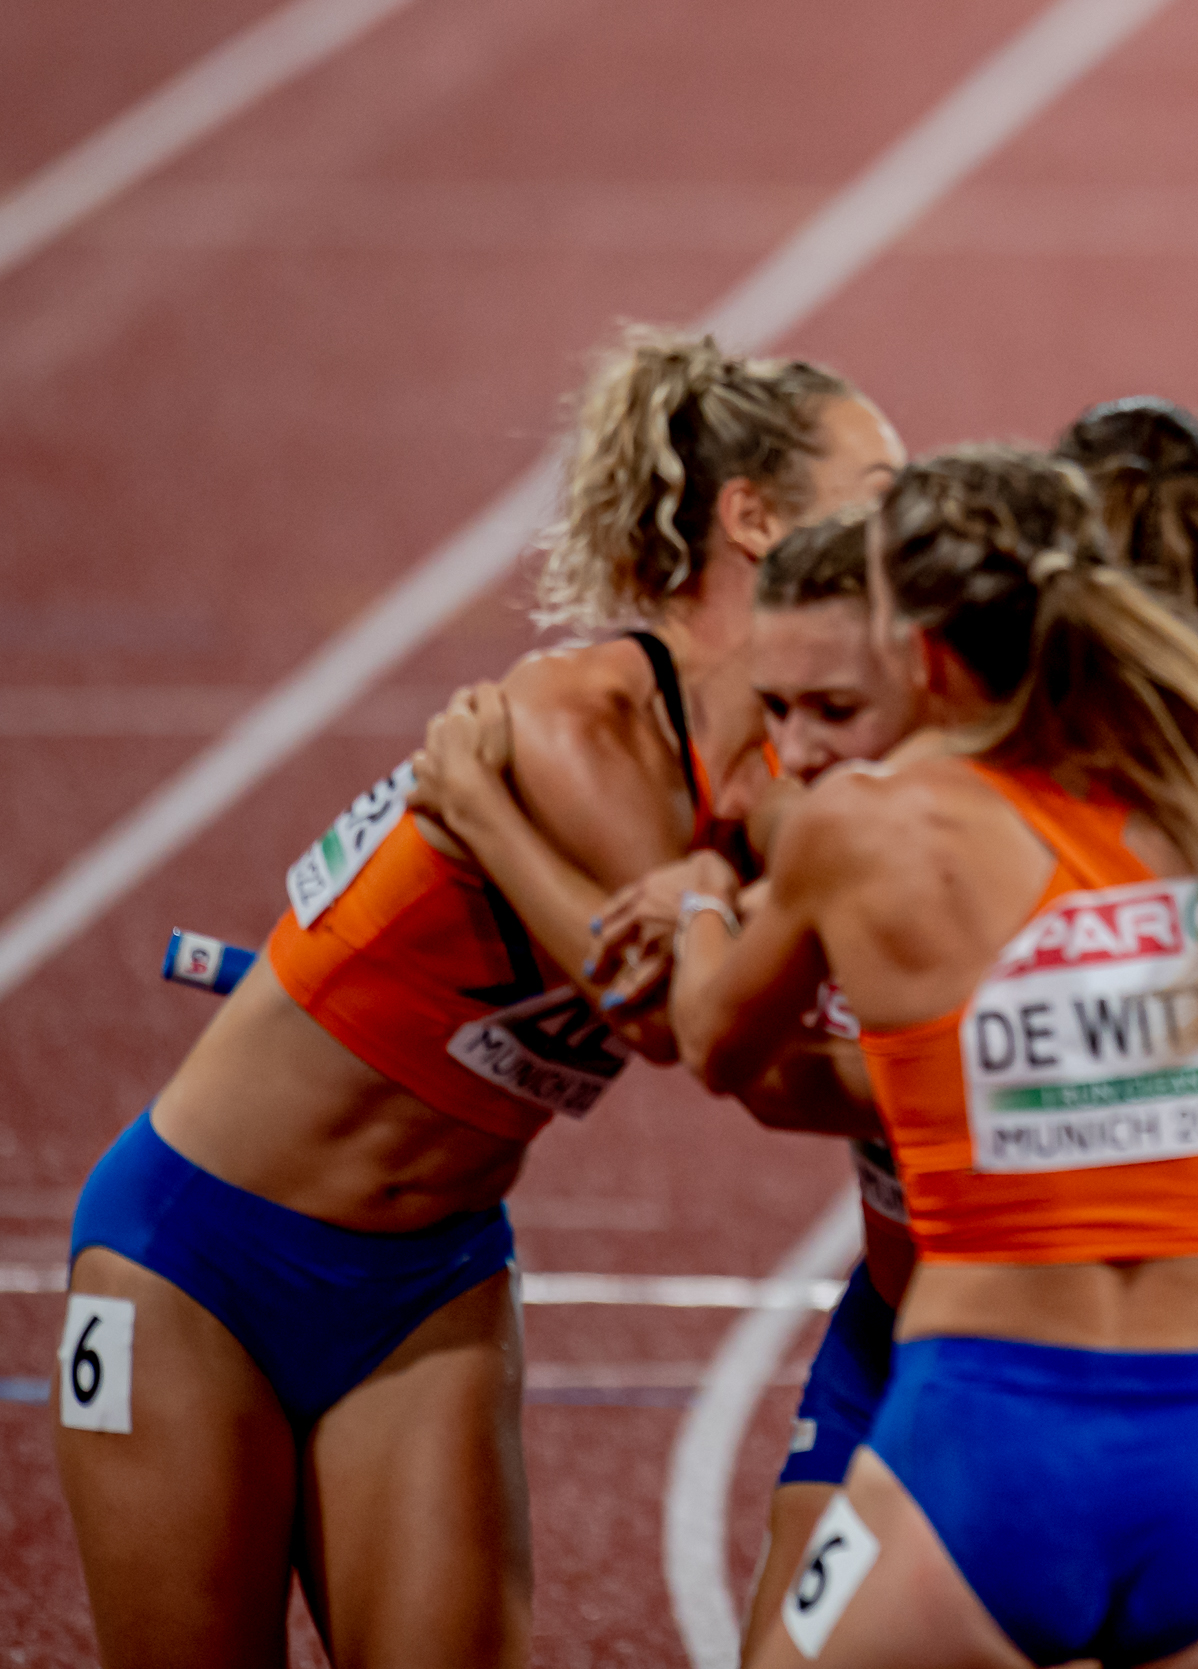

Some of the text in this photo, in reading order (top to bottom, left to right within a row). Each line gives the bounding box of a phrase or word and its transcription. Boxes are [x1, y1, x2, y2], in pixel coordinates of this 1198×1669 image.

[975, 1002, 1060, 1075] DE
[992, 1111, 1162, 1160] MUNICH
[71, 1314, 103, 1409] 6
